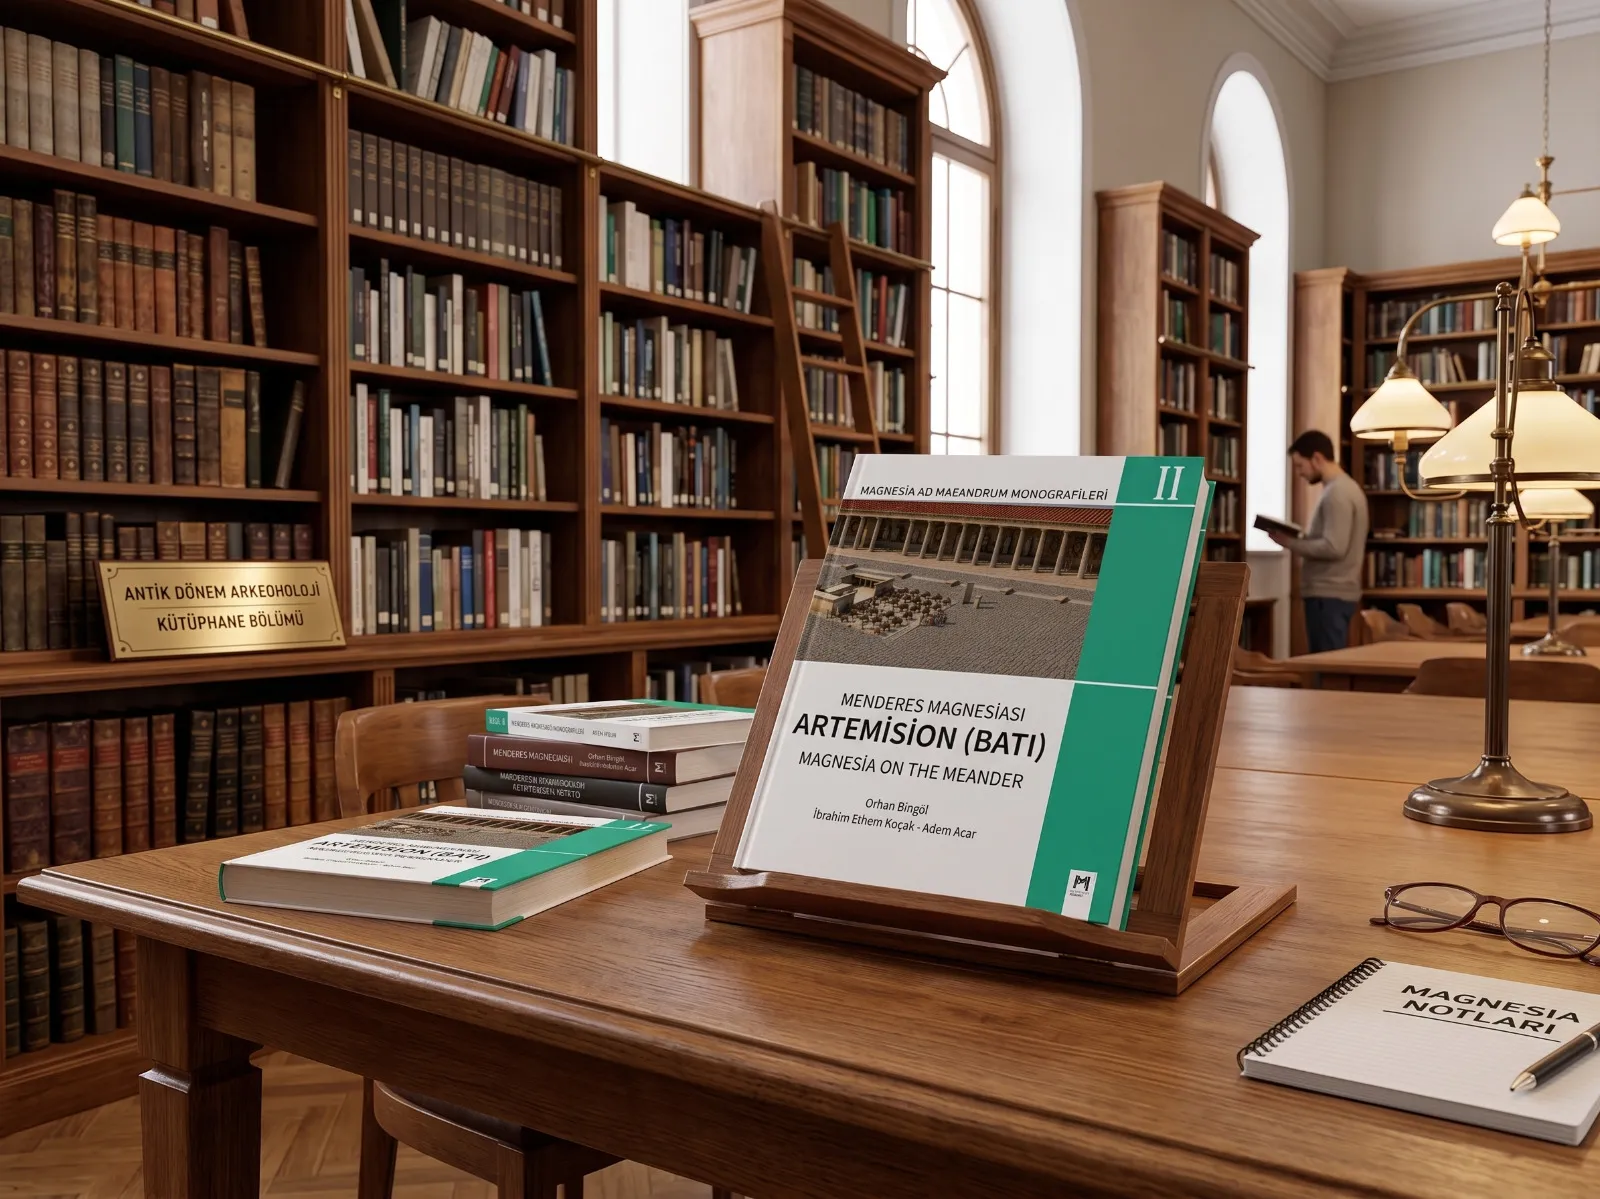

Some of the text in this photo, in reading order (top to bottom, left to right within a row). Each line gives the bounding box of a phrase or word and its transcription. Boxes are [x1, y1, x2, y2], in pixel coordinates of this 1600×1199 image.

[860, 485, 1108, 501] MAGNESİA AD MAEANDRUM MONOGRAFİLERİ
[1153, 466, 1186, 501] II
[124, 580, 321, 601] ANTİK DÖNEM ARKEOHOLOJİ
[156, 609, 304, 632] KÜTÜPHANE BÖLÜMÜ
[841, 692, 1026, 722] MENDERES MAGNESİASI
[792, 712, 1046, 763] ARTEMİSİON (BATI)
[798, 751, 1024, 789] MAGNESİA ON THE MEANDER
[813, 807, 850, 823] İbrahim
[851, 814, 883, 828] Ethem
[885, 818, 915, 833] Koçak
[922, 823, 952, 836] Adem
[953, 827, 977, 839] Acar
[865, 798, 929, 817] Orhan Bingöl
[1401, 984, 1580, 1024] MAGNESIA
[1402, 999, 1556, 1035] NOTLARI
